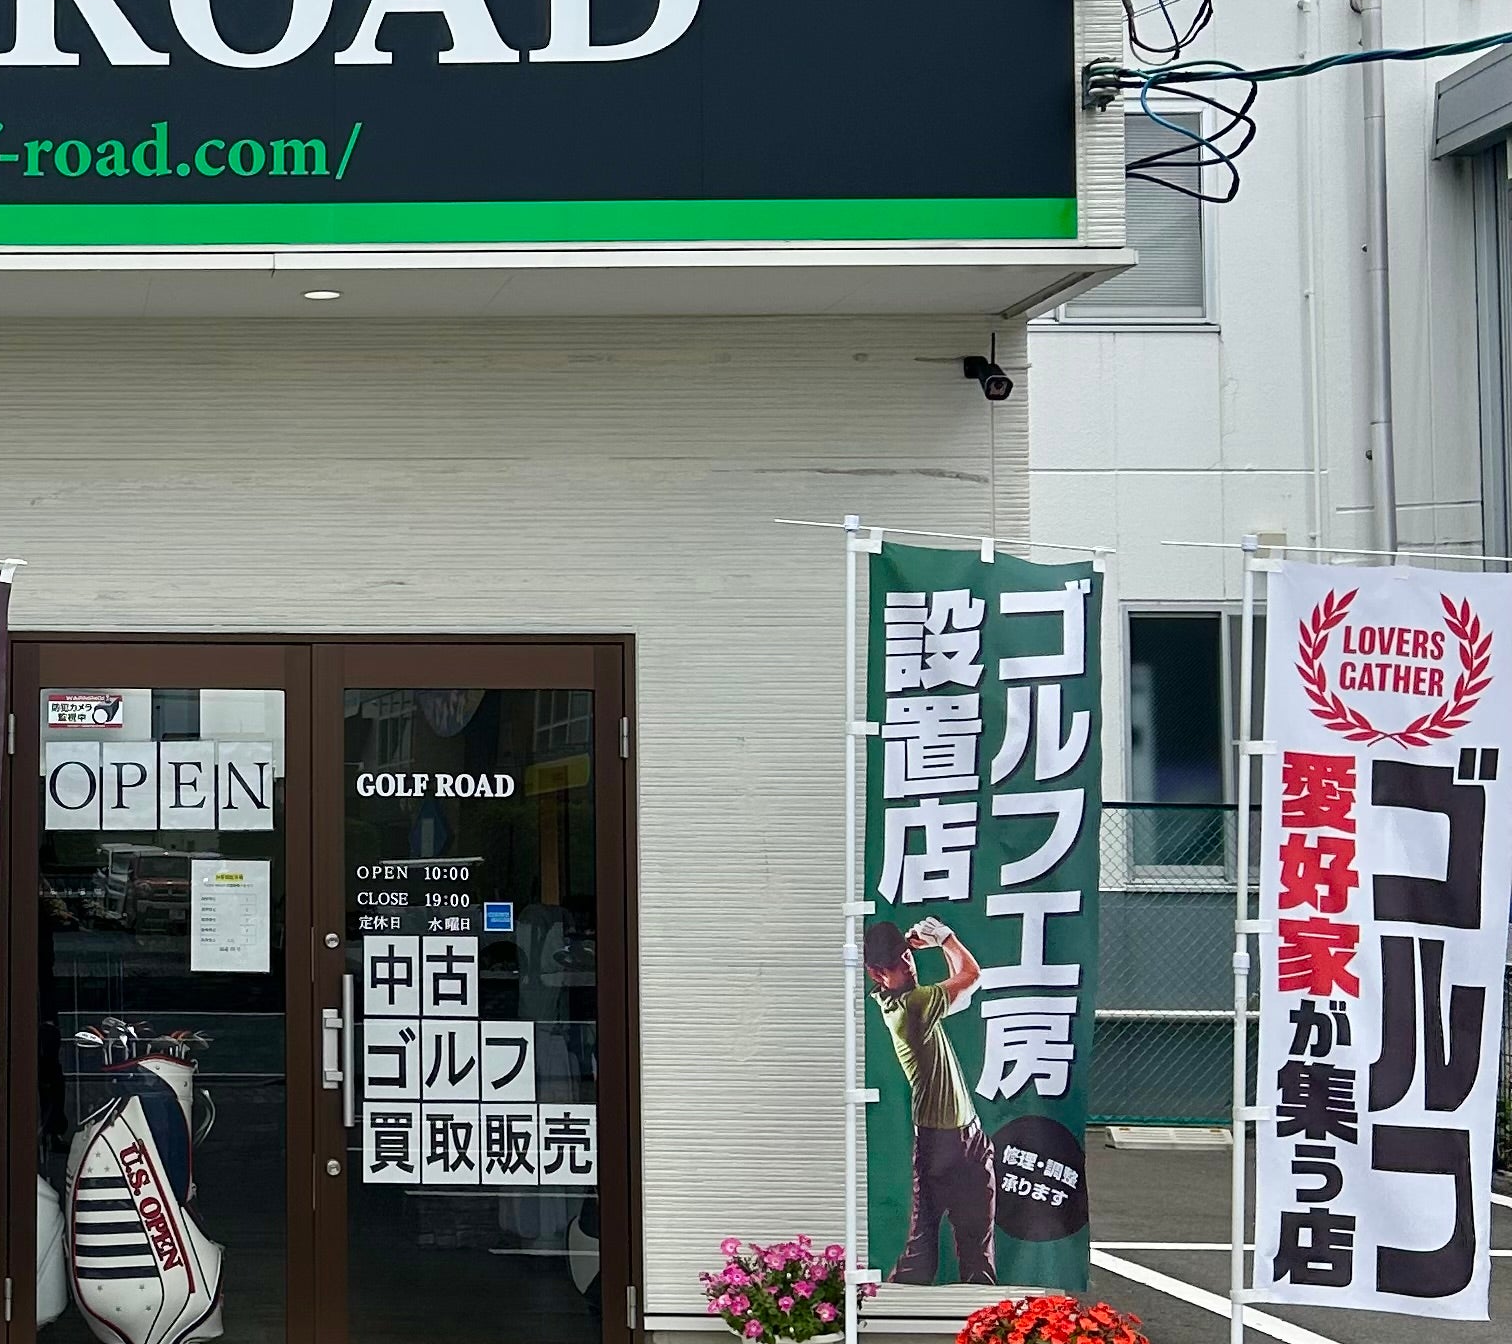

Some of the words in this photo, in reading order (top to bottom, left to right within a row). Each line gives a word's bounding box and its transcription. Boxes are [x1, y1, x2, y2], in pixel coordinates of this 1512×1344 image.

[1343, 626, 1445, 660] LOVERS
[1339, 661, 1445, 697] GATHER
[878, 589, 985, 905] 設置店
[49, 761, 271, 810] OPEN
[356, 773, 429, 797] GOLF
[435, 773, 515, 798] ROAD
[976, 578, 1091, 1101] ゴルフ工房
[356, 866, 408, 879] OPEN
[424, 866, 469, 881] 10:00
[357, 892, 409, 905] CLOSE
[424, 893, 470, 907] 19:00
[359, 916, 401, 930] 定休日
[428, 917, 471, 931] 水曜日
[370, 944, 475, 1006] 中古
[1273, 751, 1360, 1288] 愛好家が集う店
[1369, 748, 1498, 1296] ゴルフ
[367, 1027, 529, 1090] ゴルフ
[370, 1111, 593, 1174] 買取販売
[1002, 1145, 1079, 1189] 修理・調整
[119, 1141, 150, 1197] U.S.
[139, 1196, 184, 1271] OPEN
[1001, 1173, 1068, 1206] 承ります
